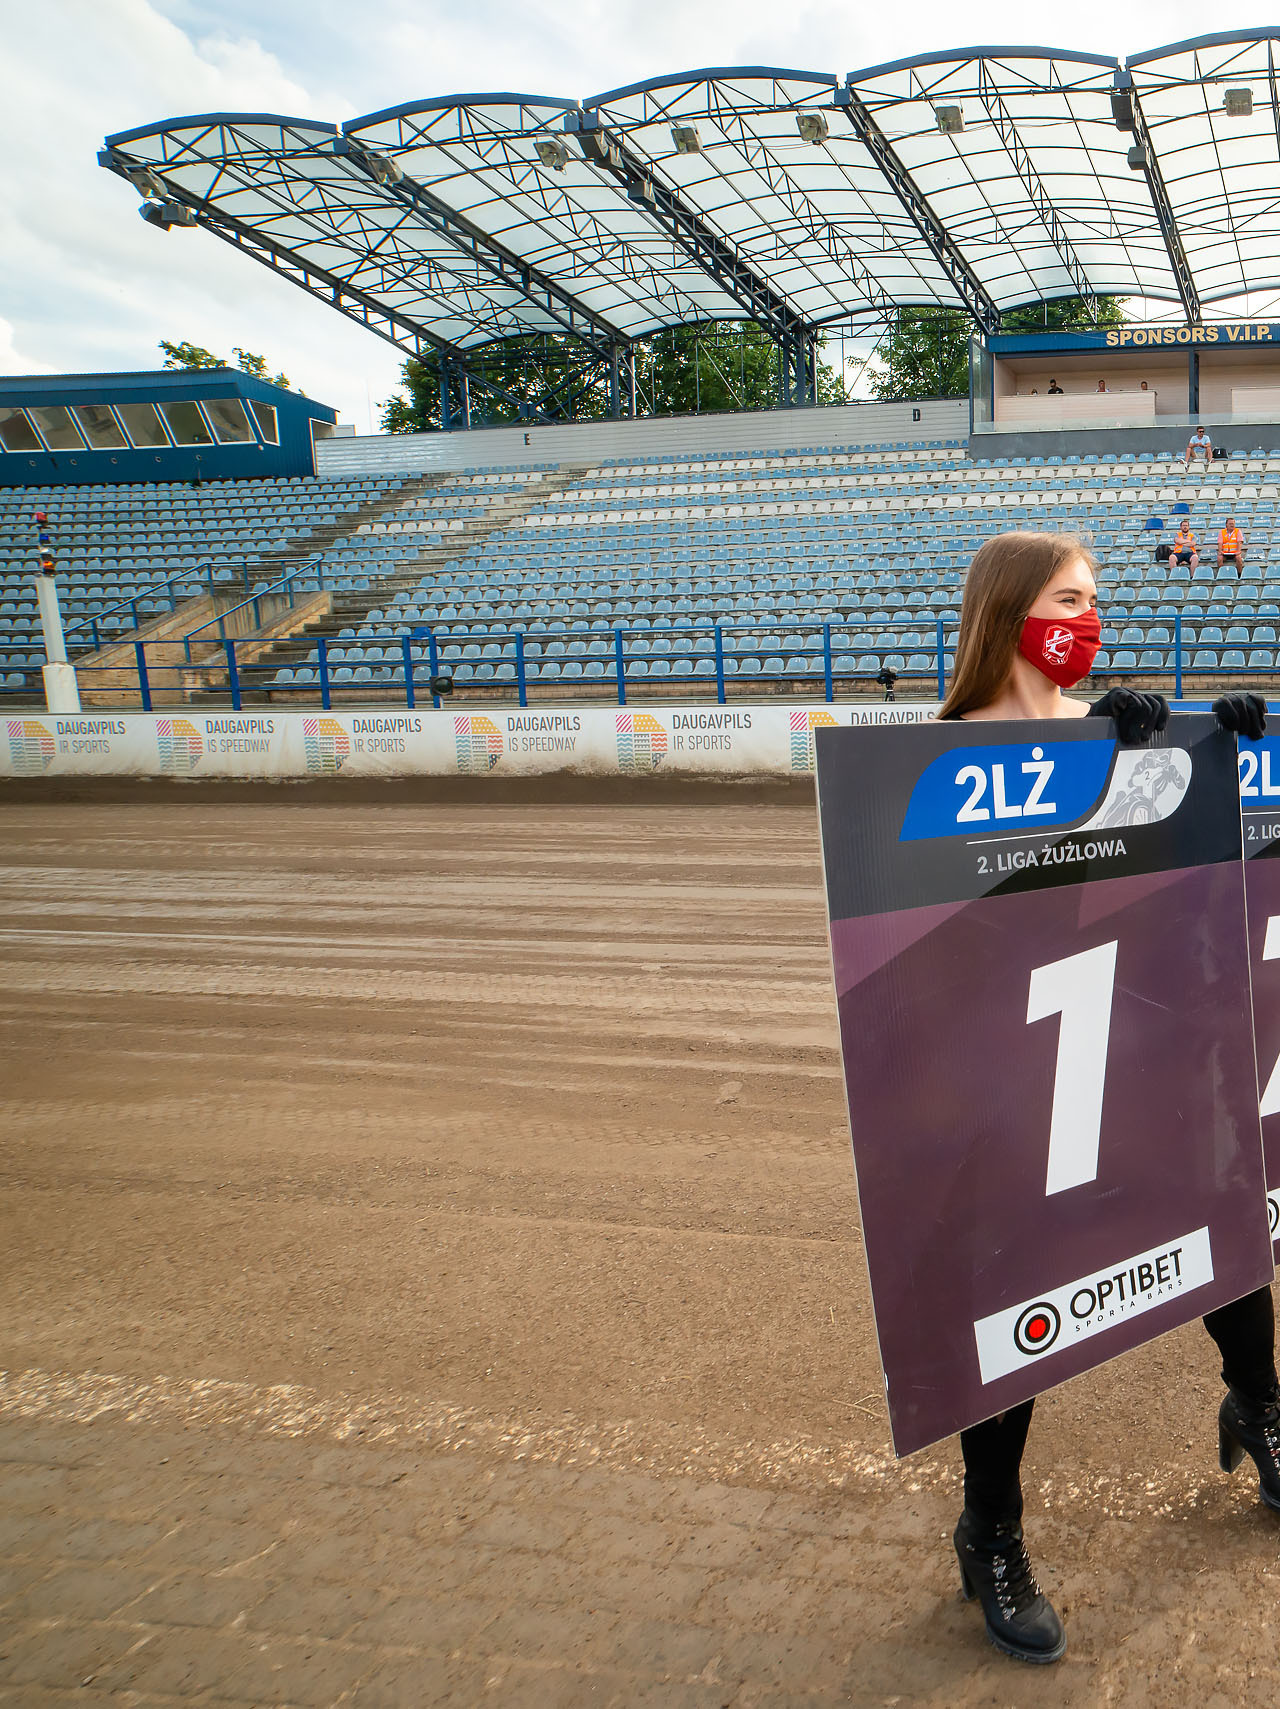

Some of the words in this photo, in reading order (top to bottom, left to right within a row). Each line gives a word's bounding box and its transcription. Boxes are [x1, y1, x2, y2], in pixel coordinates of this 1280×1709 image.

[1106, 326, 1219, 346] SPONSORS
[1226, 325, 1273, 341] V.I.P.
[524, 433, 531, 445] E
[56, 720, 127, 735] DAUGAVPILS
[206, 719, 275, 734] DAUGAVPILS
[353, 718, 422, 733] DAUGAVPILS
[507, 716, 581, 732] DAUGAVPILS
[672, 713, 752, 730] DAUGAVPILS
[207, 738, 217, 753] IS
[220, 738, 271, 753] SPEEDWAY
[354, 738, 365, 753] IR
[367, 738, 406, 753] SPORTS
[508, 736, 518, 752] IS
[521, 736, 577, 752] SPEEDWAY
[673, 735, 684, 751] IR
[688, 735, 732, 751] SPORTS
[954, 746, 1057, 824] 2LŻ
[1247, 826, 1259, 841] 2.
[976, 856, 993, 875] 2.
[998, 850, 1039, 872] LIGA
[1042, 838, 1128, 867] ŻUŻLOWA
[1025, 939, 1119, 1197] 1
[1069, 1247, 1184, 1319] OPTIBET
[1074, 1298, 1137, 1333] SPORTA
[1146, 1277, 1185, 1302] BĀRS
